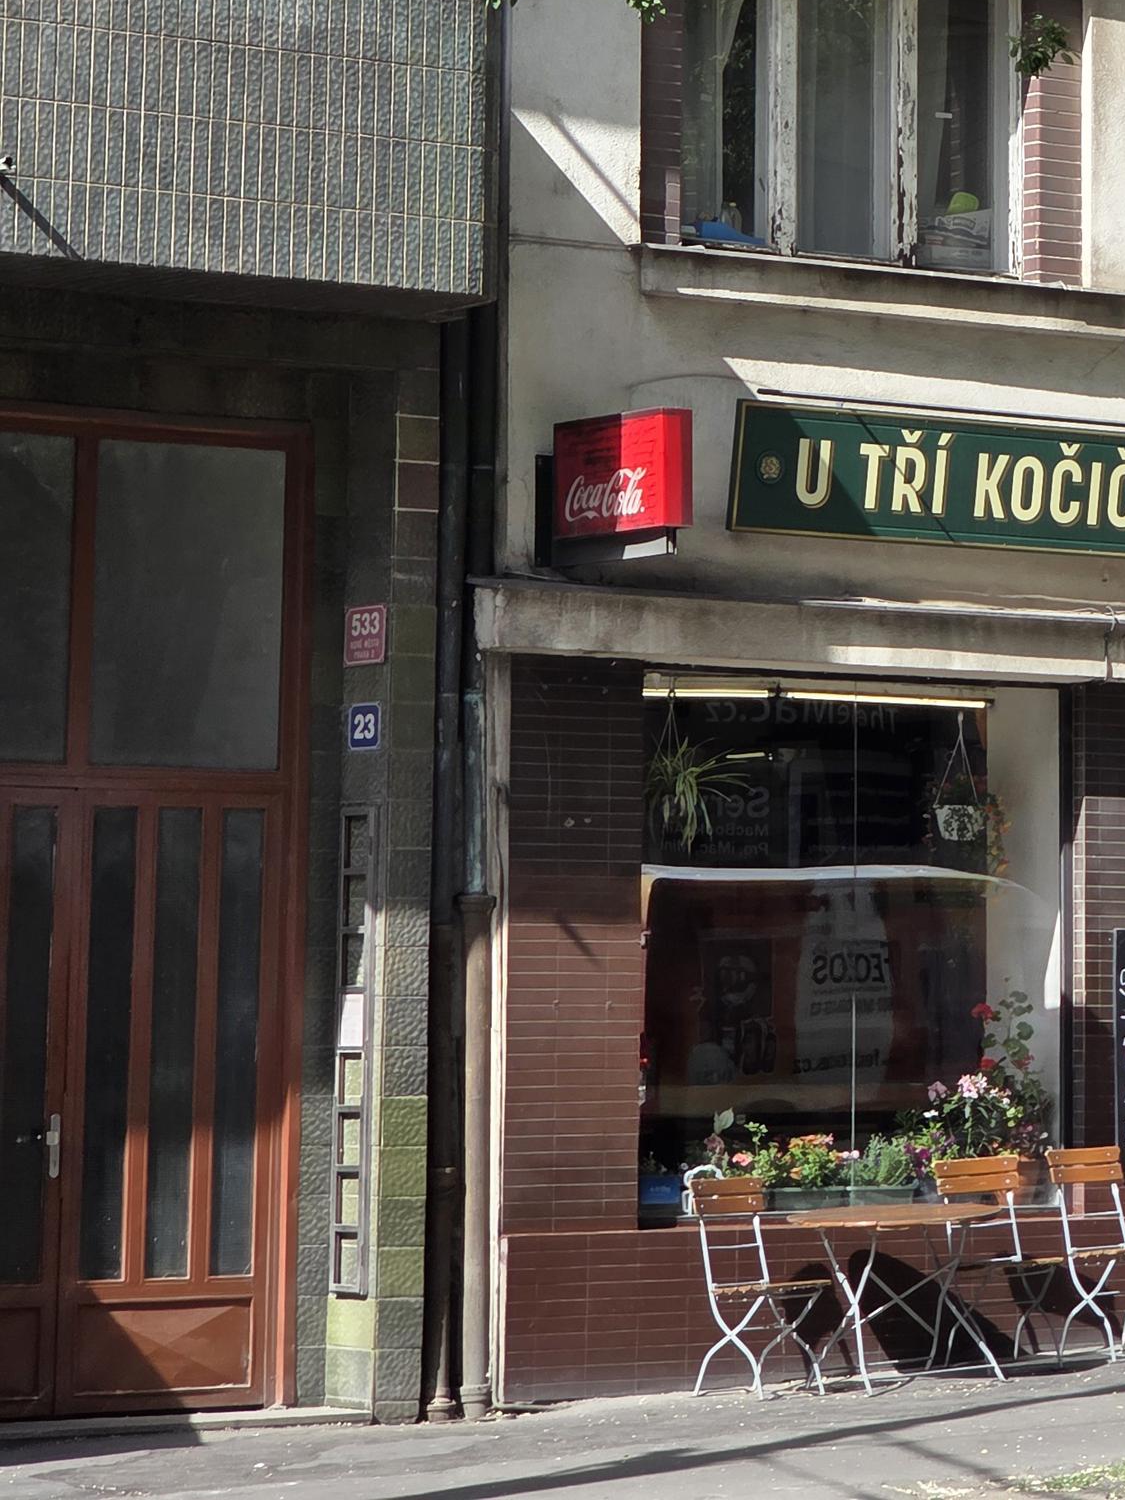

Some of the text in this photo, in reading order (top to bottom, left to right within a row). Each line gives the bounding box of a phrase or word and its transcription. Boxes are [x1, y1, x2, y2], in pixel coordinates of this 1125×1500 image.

[795, 438, 832, 506] U
[859, 428, 953, 515] TŘÍ
[351, 611, 380, 636] 533
[353, 713, 375, 739] 23
